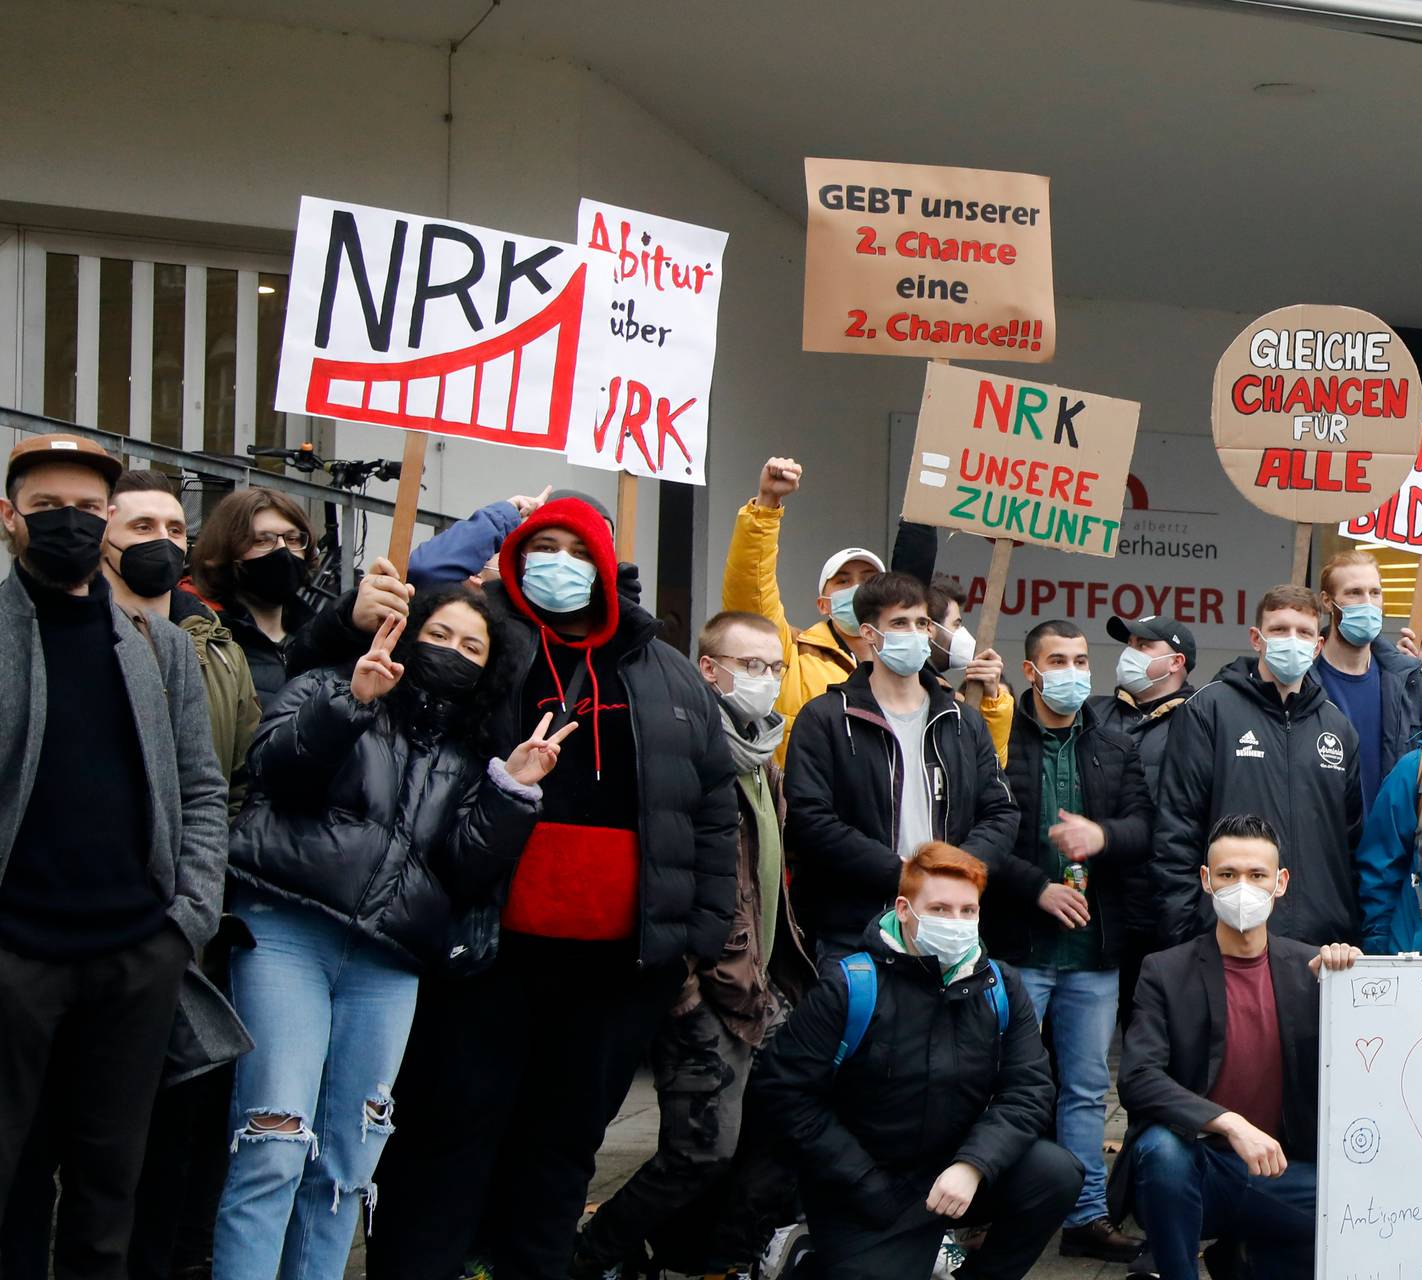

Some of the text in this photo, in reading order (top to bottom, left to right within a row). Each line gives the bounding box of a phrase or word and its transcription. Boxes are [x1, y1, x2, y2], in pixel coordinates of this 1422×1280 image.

[818, 184, 1040, 227] GEBT unserer
[588, 212, 713, 294] Abitur
[855, 226, 1017, 265] 2. Chance
[314, 210, 564, 353] NRK
[896, 275, 968, 304] eine
[610, 299, 672, 347] über
[845, 309, 1043, 352] 2. Chance!!!
[1249, 328, 1391, 372] GLEICHE
[973, 379, 1086, 449] NRK
[1231, 374, 1409, 418] CHANCEN
[1292, 412, 1349, 444] FÜR
[960, 447, 1100, 508] UNSERE
[1254, 448, 1373, 493] ALLE
[949, 485, 1119, 553] ZUKUNFT
[1134, 520, 1188, 534] albertz
[1118, 535, 1218, 559] erhausen
[936, 573, 1224, 625] AUPTFOYER
